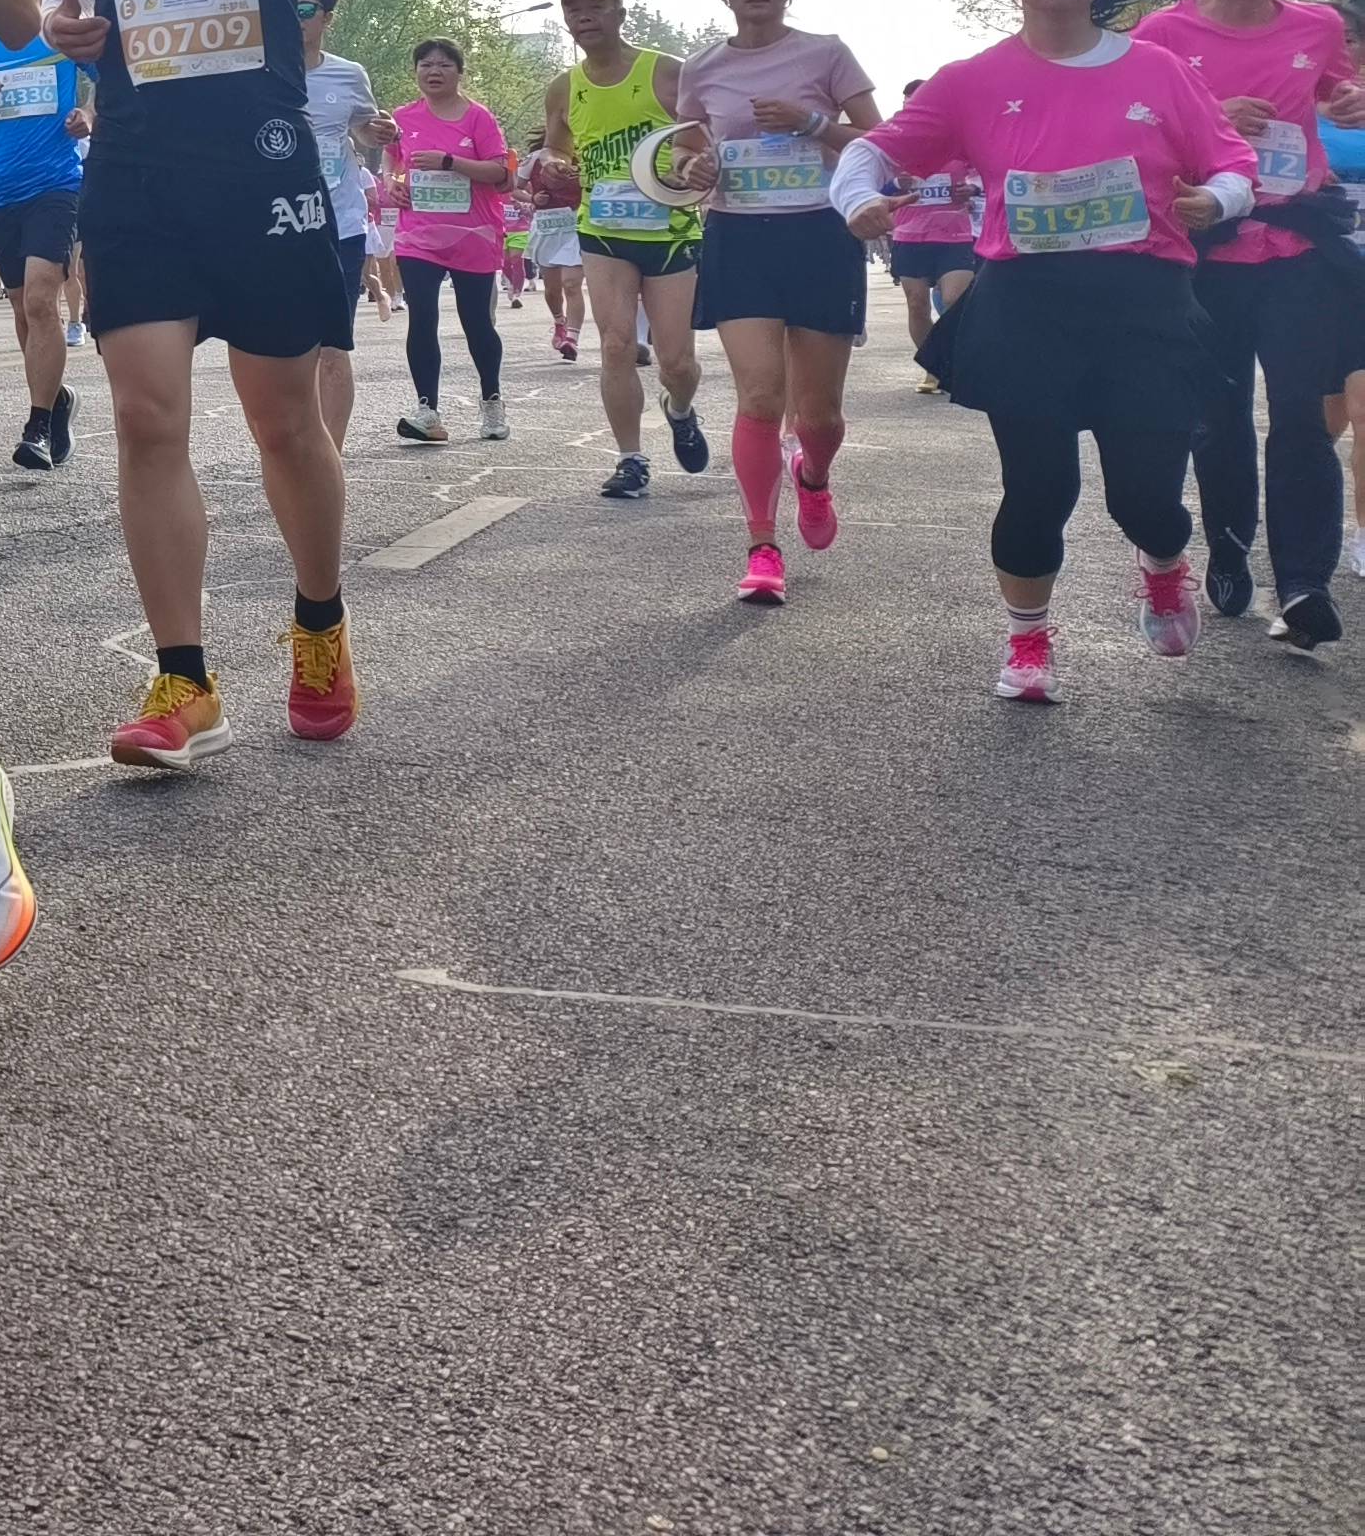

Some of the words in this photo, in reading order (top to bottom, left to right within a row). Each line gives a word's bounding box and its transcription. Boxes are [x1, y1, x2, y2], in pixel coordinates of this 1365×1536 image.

[122, 0, 133, 17] E
[127, 15, 251, 61] 60709
[728, 165, 822, 190] 51962
[1012, 179, 1023, 195] E
[1015, 195, 1134, 233] 51937
